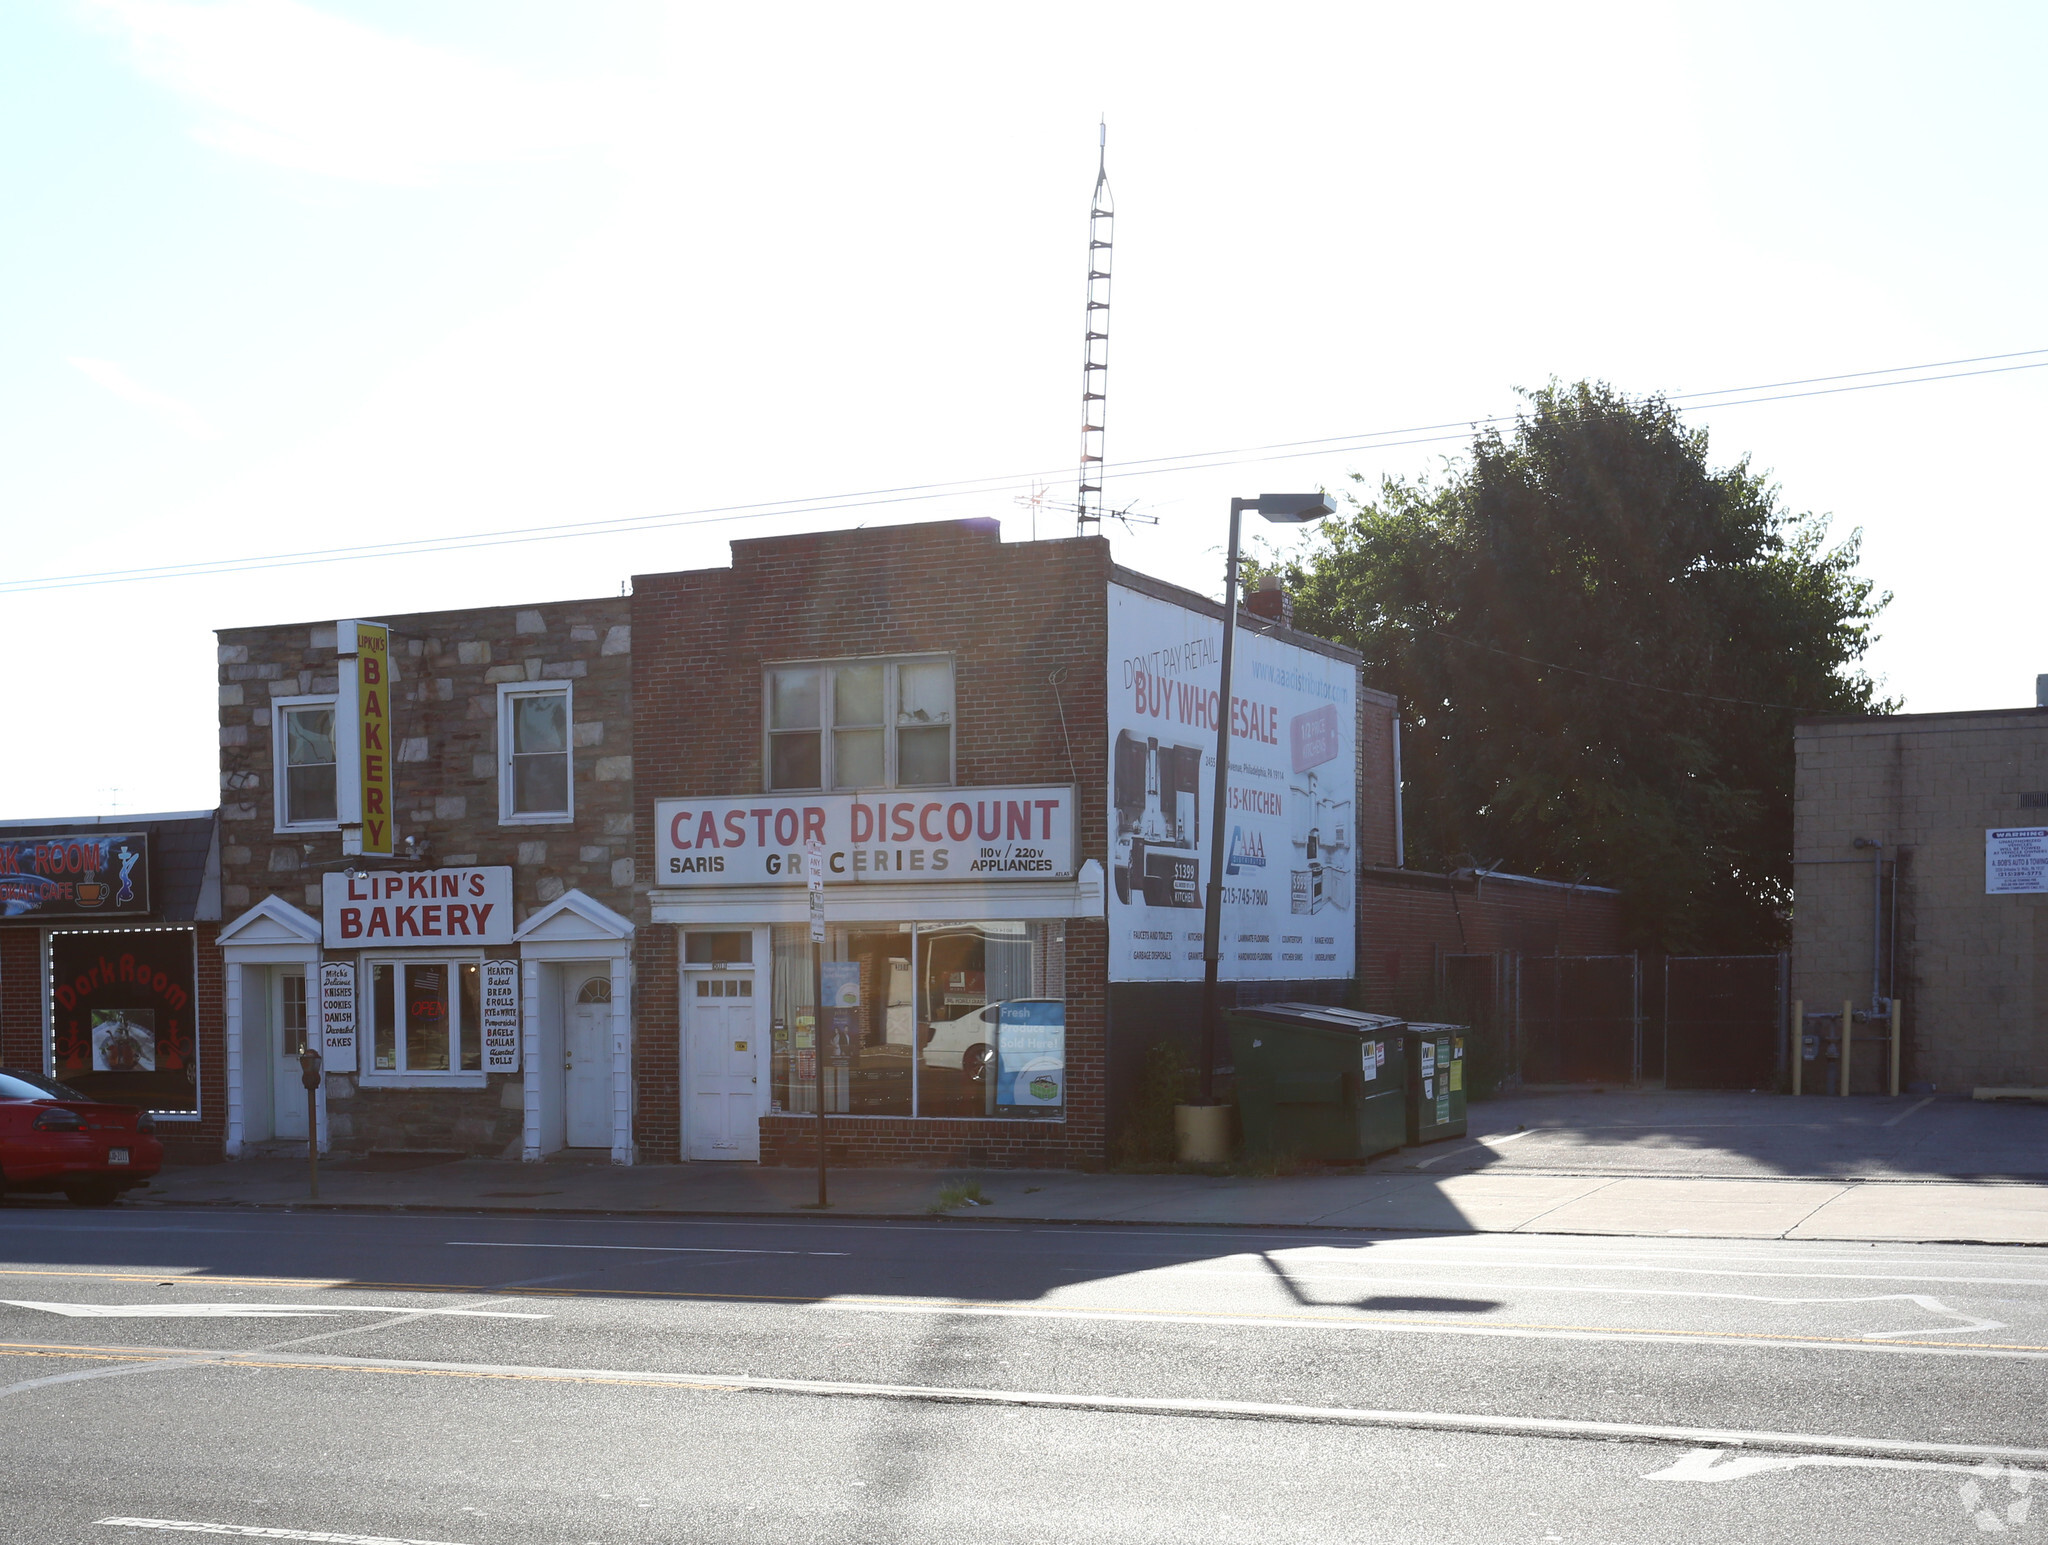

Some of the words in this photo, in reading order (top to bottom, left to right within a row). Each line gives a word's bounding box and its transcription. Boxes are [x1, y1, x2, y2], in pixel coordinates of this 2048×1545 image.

[357, 634, 386, 655] LIPKIN'S
[1123, 651, 1161, 690] DON'T
[1161, 644, 1181, 678] PAY
[1184, 637, 1219, 672] RETAIL
[1135, 670, 1174, 721] BUY
[1177, 681, 1278, 745] WHOESALE
[364, 657, 385, 847] BAKERY
[1205, 756, 1216, 767] 2455
[670, 807, 826, 850] CASTOR
[851, 800, 1059, 843] DISCOUNT
[1240, 831, 1265, 858] AAA
[35, 843, 101, 875] ROOM
[670, 856, 725, 874] SARIS
[766, 849, 949, 875] GRCERIES
[810, 857, 821, 867] ANY
[2012, 858, 2025, 866] AUTO
[970, 859, 1054, 872] APPLIANCES
[1174, 861, 1195, 879] $1399
[810, 867, 821, 877] TIME
[41, 882, 74, 901] CAFE
[347, 872, 485, 901] LIPKIN'S
[1175, 891, 1195, 903] KITCHEN
[1222, 887, 1268, 906] 215-745-7900
[340, 903, 494, 939] BAKERY
[1133, 930, 1150, 940] FAUCETS
[1150, 931, 1159, 940] AND
[1159, 931, 1173, 941] TOILETS
[1133, 951, 1151, 960] GARBAGE
[1151, 951, 1172, 960] DISPOSALS
[487, 966, 514, 976] HEARTH
[324, 978, 351, 986] Delicious
[488, 977, 510, 986] Baked
[325, 987, 352, 997] KNISHES
[487, 988, 512, 997] BREAD
[323, 1000, 352, 1010] COOKIES
[491, 998, 514, 1006] ROLLS
[411, 1001, 447, 1016] OPEN
[1001, 1007, 1031, 1018] Fresh
[325, 1012, 352, 1023] DANISH
[487, 1028, 514, 1038] BAGELS
[1001, 1022, 1047, 1034] Produce
[326, 1037, 352, 1048] CAKES
[486, 1038, 515, 1047] CHALLAH
[1001, 1037, 1025, 1049] Sold
[1028, 1036, 1058, 1049] Here!
[1363, 1042, 1375, 1057] WM
[1422, 1046, 1435, 1059] WM
[489, 1056, 512, 1066] ROLLS
